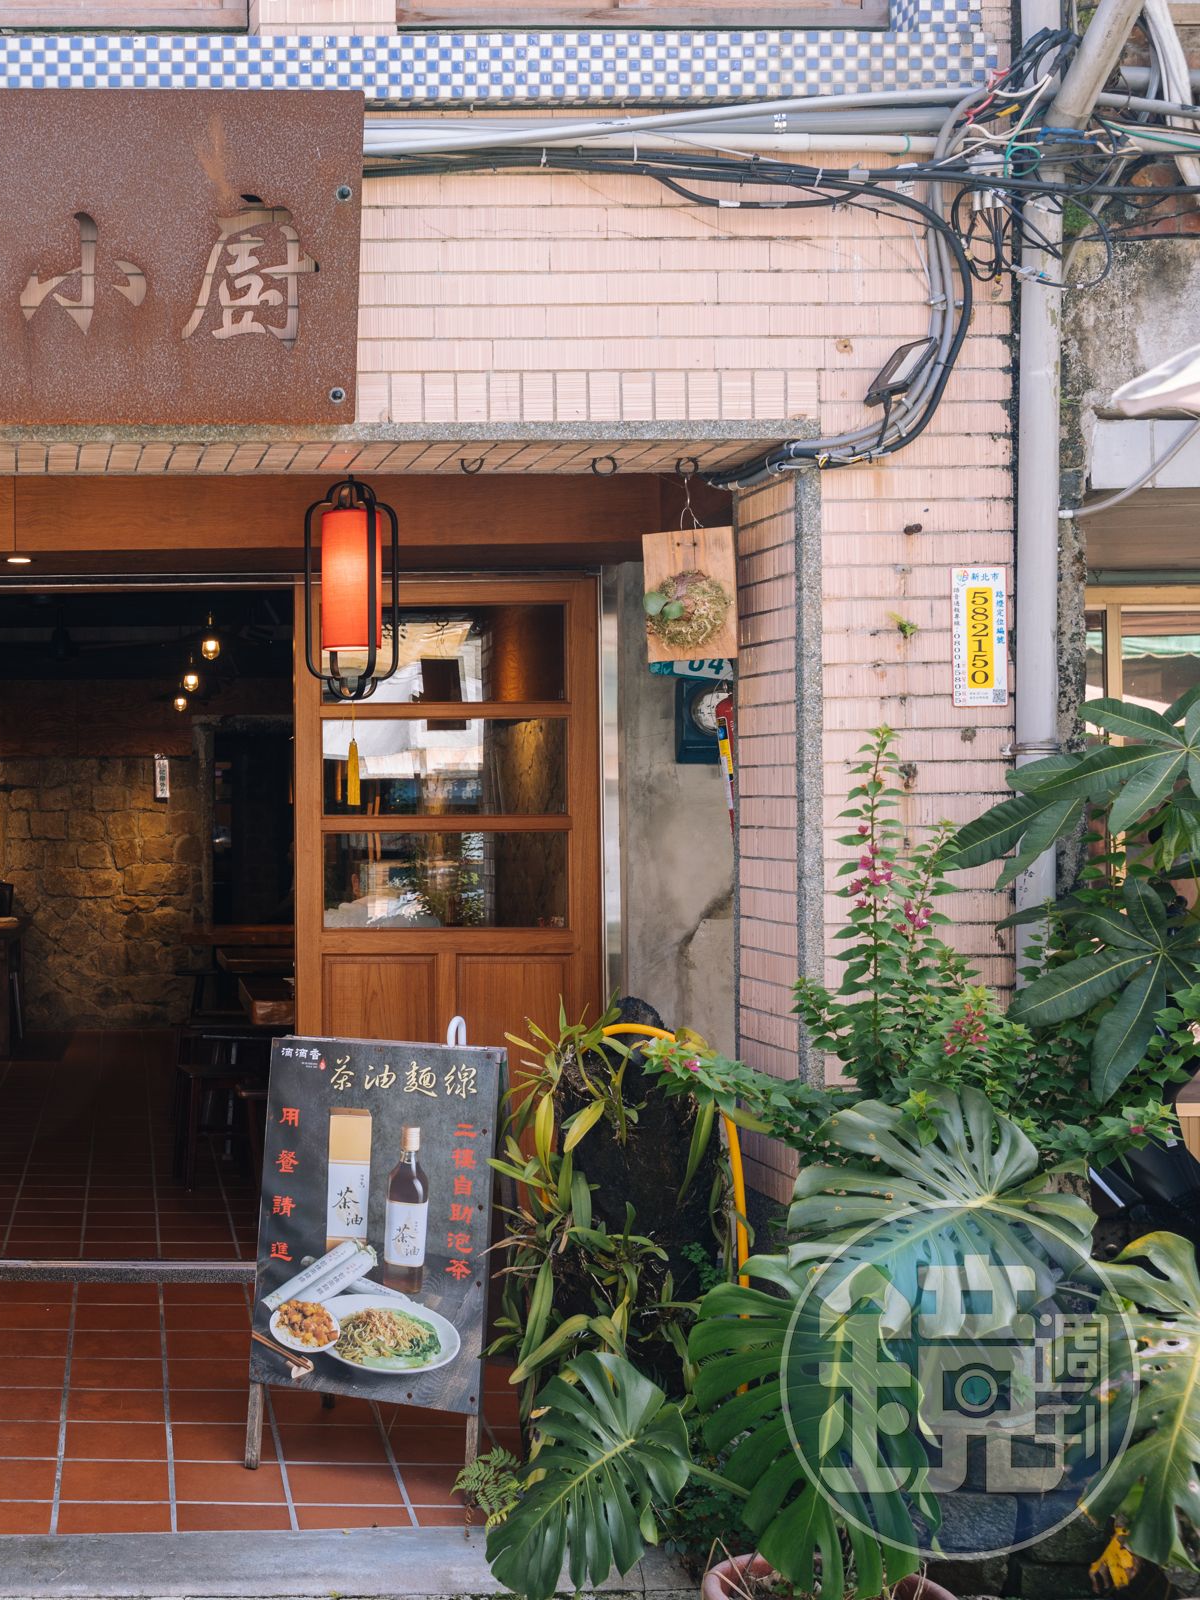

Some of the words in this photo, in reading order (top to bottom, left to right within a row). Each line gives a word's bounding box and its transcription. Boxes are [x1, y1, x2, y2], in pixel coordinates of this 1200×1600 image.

[971, 573, 1000, 582] 新北市
[971, 592, 989, 684] 582150
[281, 1047, 321, 1060] 滴滴香
[330, 1055, 478, 1099] 茶油麵線
[270, 1107, 300, 1262] 用餐請進
[445, 1123, 477, 1280] 二樓自助泡茶
[332, 1186, 363, 1226] 茶油
[392, 1224, 420, 1256] 茶油
